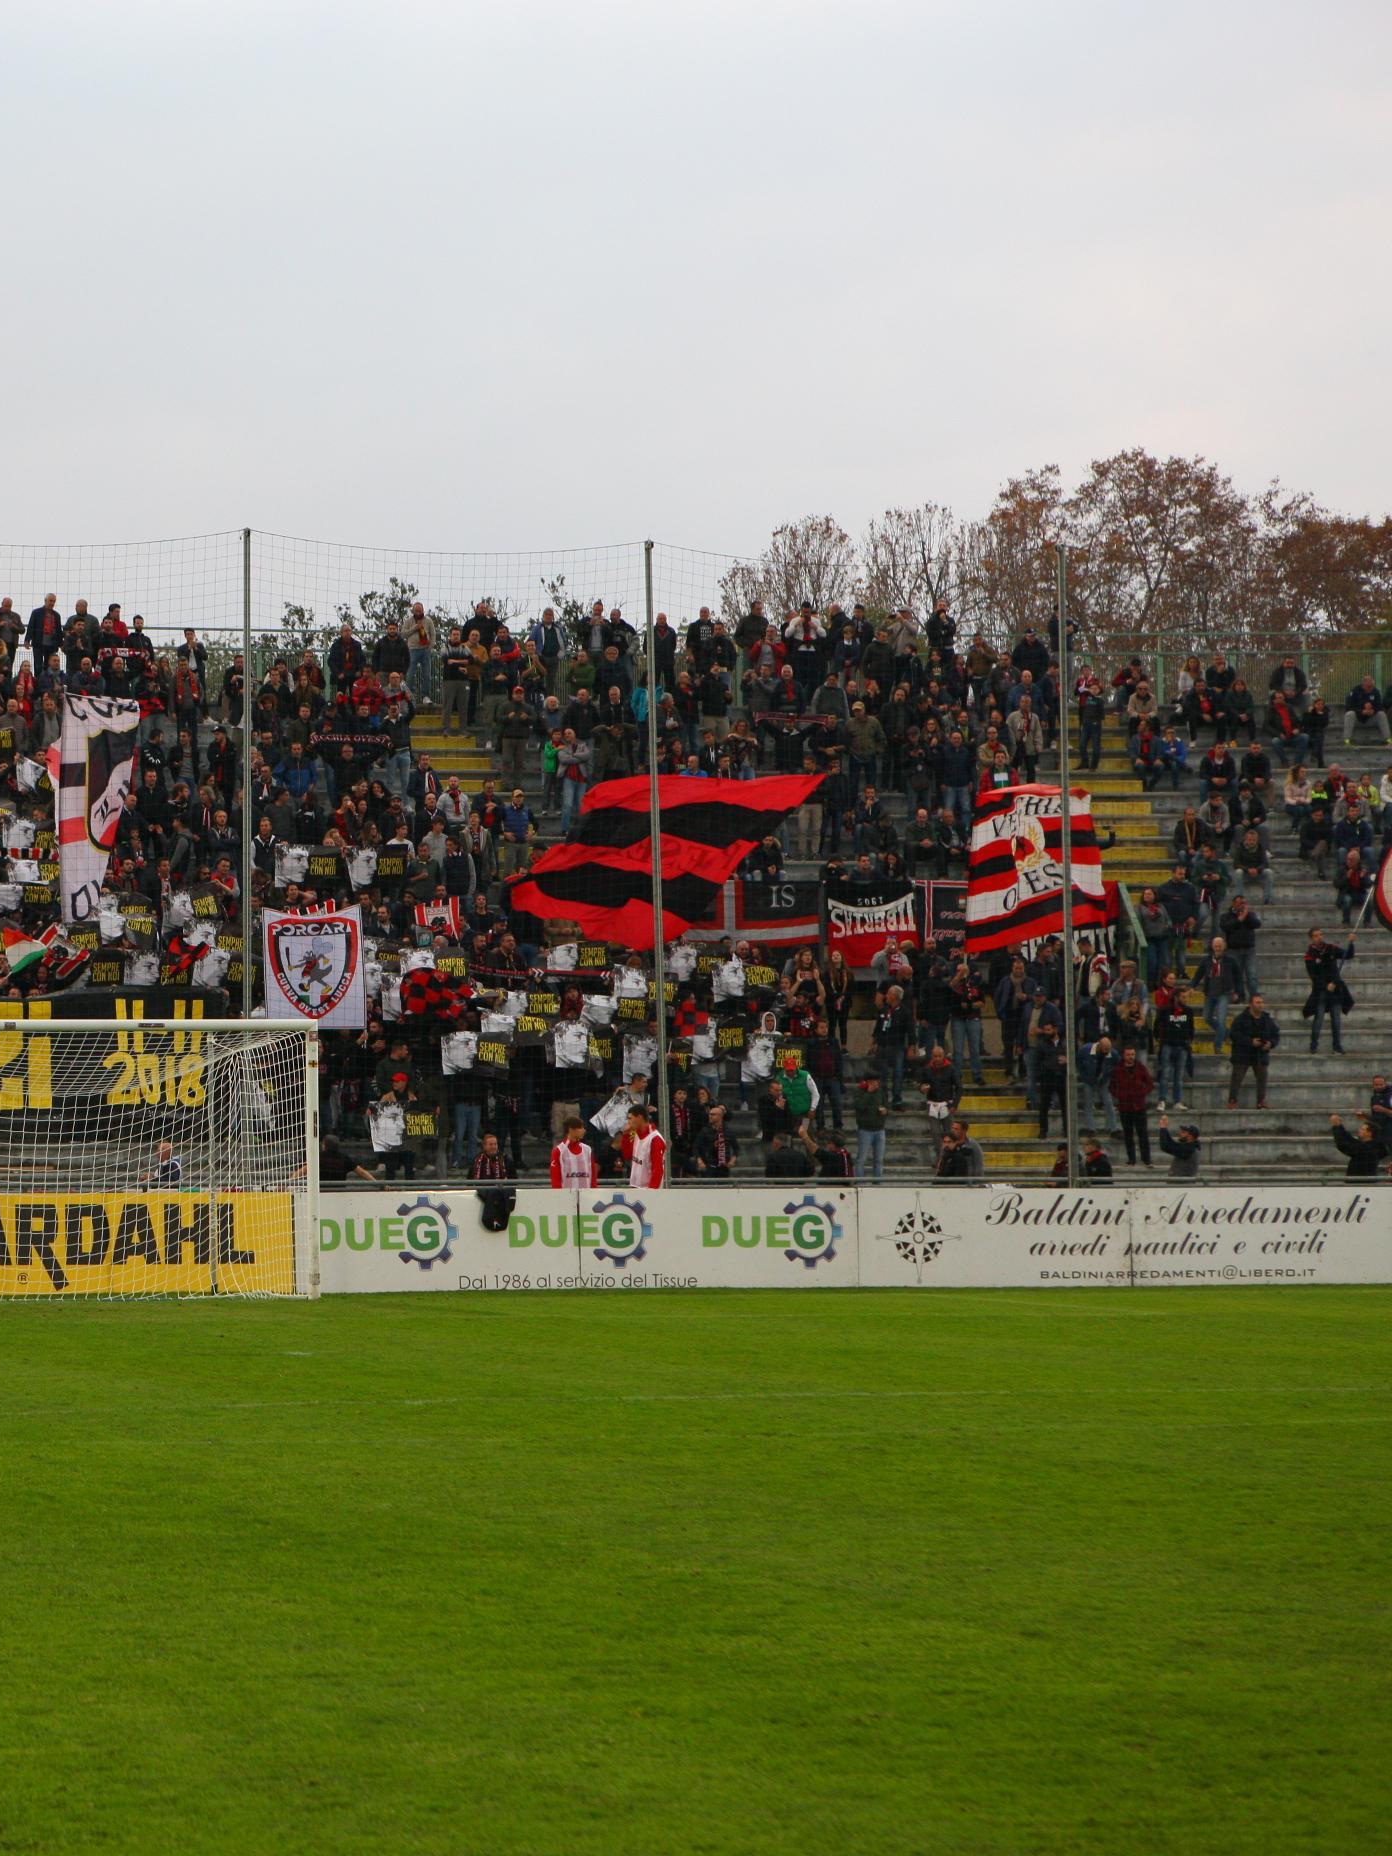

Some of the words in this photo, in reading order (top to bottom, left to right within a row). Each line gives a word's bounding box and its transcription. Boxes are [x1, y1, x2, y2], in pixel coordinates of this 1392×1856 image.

[311, 857, 336, 866] SEMPRE
[379, 858, 403, 866] SEMPRE
[310, 865, 324, 874] CON
[324, 866, 336, 875] NOI
[378, 866, 391, 875] CON
[392, 866, 403, 874] NOI
[271, 921, 352, 936] PORCARI
[581, 947, 605, 956] SEMPRE
[580, 956, 593, 966] CON
[594, 956, 606, 965] NOI
[93, 963, 119, 972] SEMPRE
[93, 972, 107, 981] CON
[107, 972, 120, 981] NOI
[277, 972, 298, 1004] CURVA
[298, 1002, 330, 1016] OVEST
[330, 972, 352, 1004] LUCCA
[530, 994, 556, 1003] SEMPRE
[530, 1003, 543, 1013] CON
[718, 1028, 743, 1038] SEMPRE
[480, 1042, 505, 1053] SEMPRE
[719, 1038, 731, 1048] CON
[732, 1037, 743, 1047] NOI
[479, 1051, 493, 1061] CON
[103, 1051, 206, 1107] 2018
[407, 1115, 434, 1124] SEMPRE
[407, 1125, 422, 1135] CON
[422, 1125, 435, 1135] NOI
[985, 1192, 1130, 1227] Baldini
[1144, 1193, 1371, 1226] Arredamenti
[1029, 1234, 1112, 1257] arredi
[1125, 1230, 1221, 1257] nautici
[1234, 1240, 1248, 1255] e
[1261, 1227, 1329, 1256] civili
[1040, 1264, 1317, 1280] BALDINIARREDAMENTI@LIBERO.IT
[459, 1273, 489, 1289] Dal
[493, 1273, 531, 1289] 1986
[536, 1272, 552, 1288] al
[556, 1271, 617, 1288] servizio
[621, 1271, 649, 1288] del
[652, 1271, 698, 1288] Tissue
